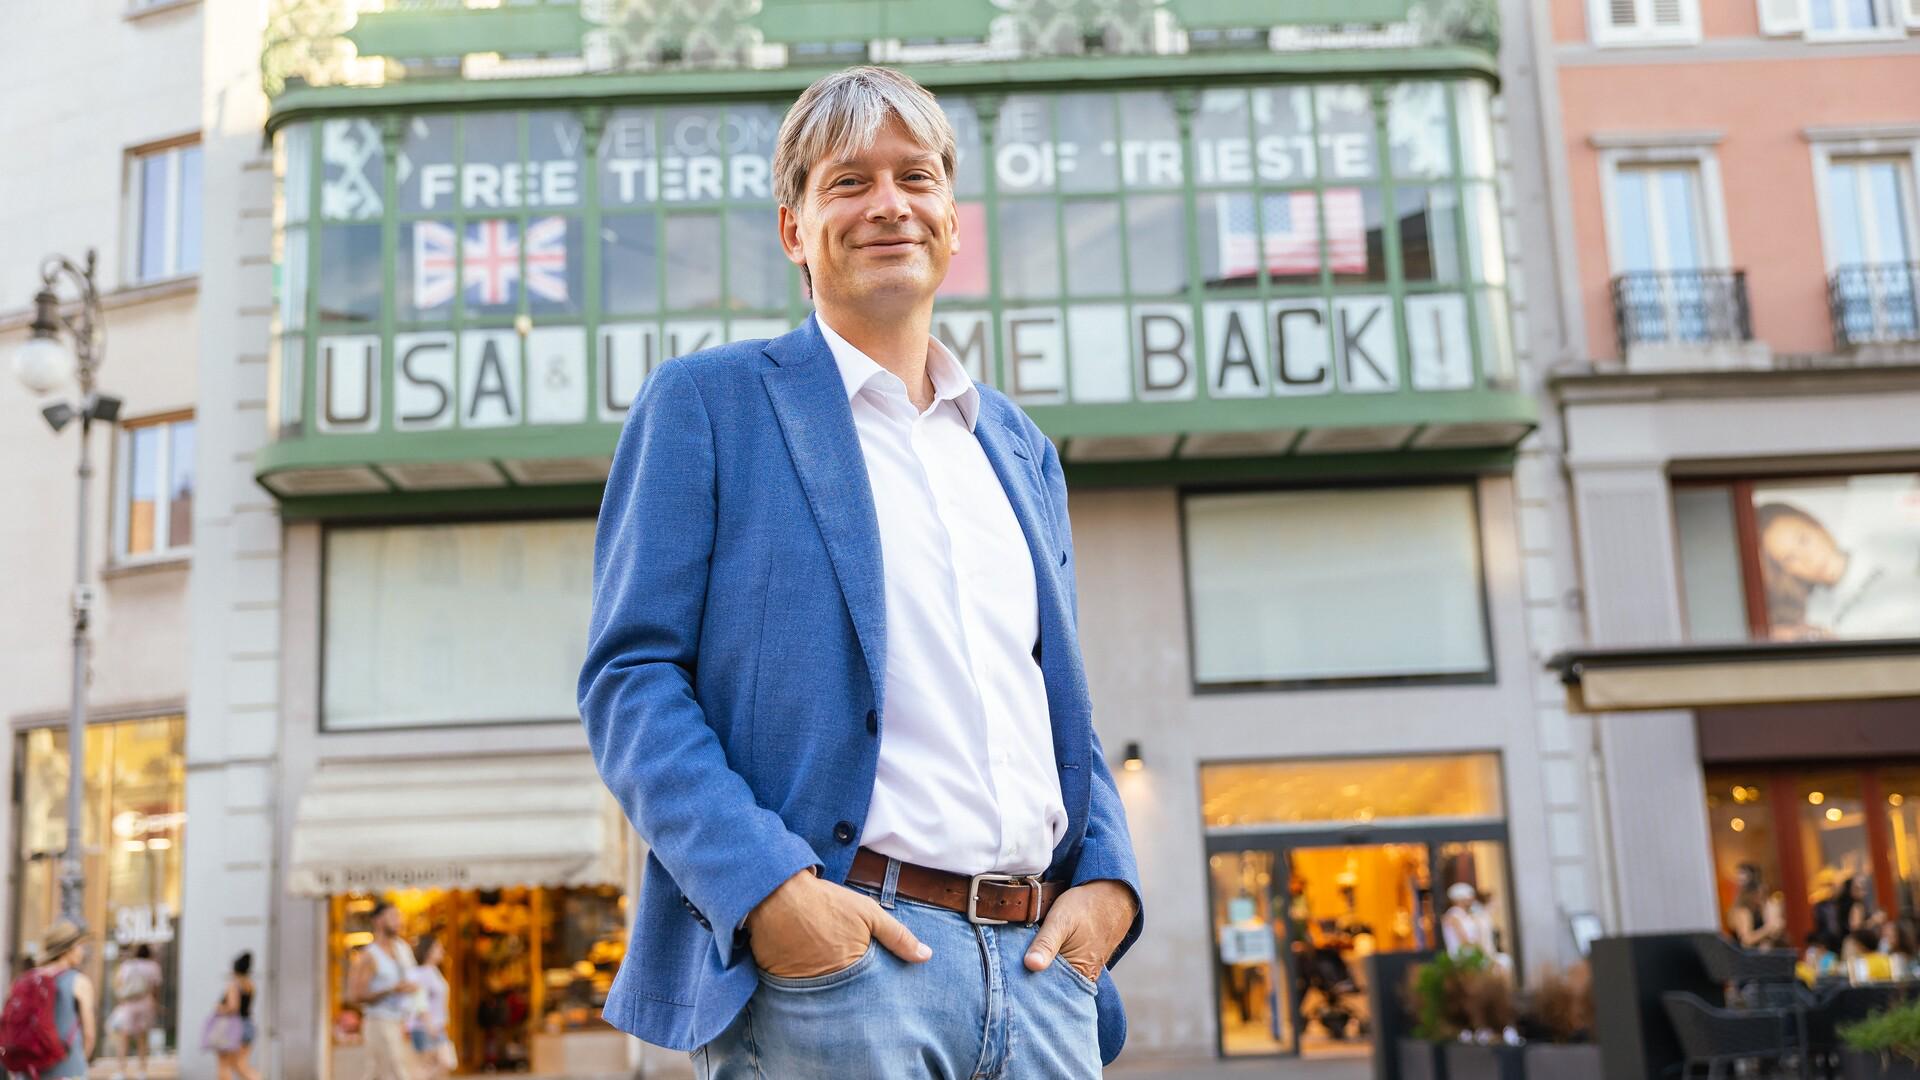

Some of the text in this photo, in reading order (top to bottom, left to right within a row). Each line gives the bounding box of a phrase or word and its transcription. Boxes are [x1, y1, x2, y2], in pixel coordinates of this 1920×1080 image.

[420, 132, 1370, 209] FREE TERR OF TRIESTE
[552, 114, 783, 157] WELCOM
[325, 338, 513, 424] USA
[938, 317, 1060, 396] ME
